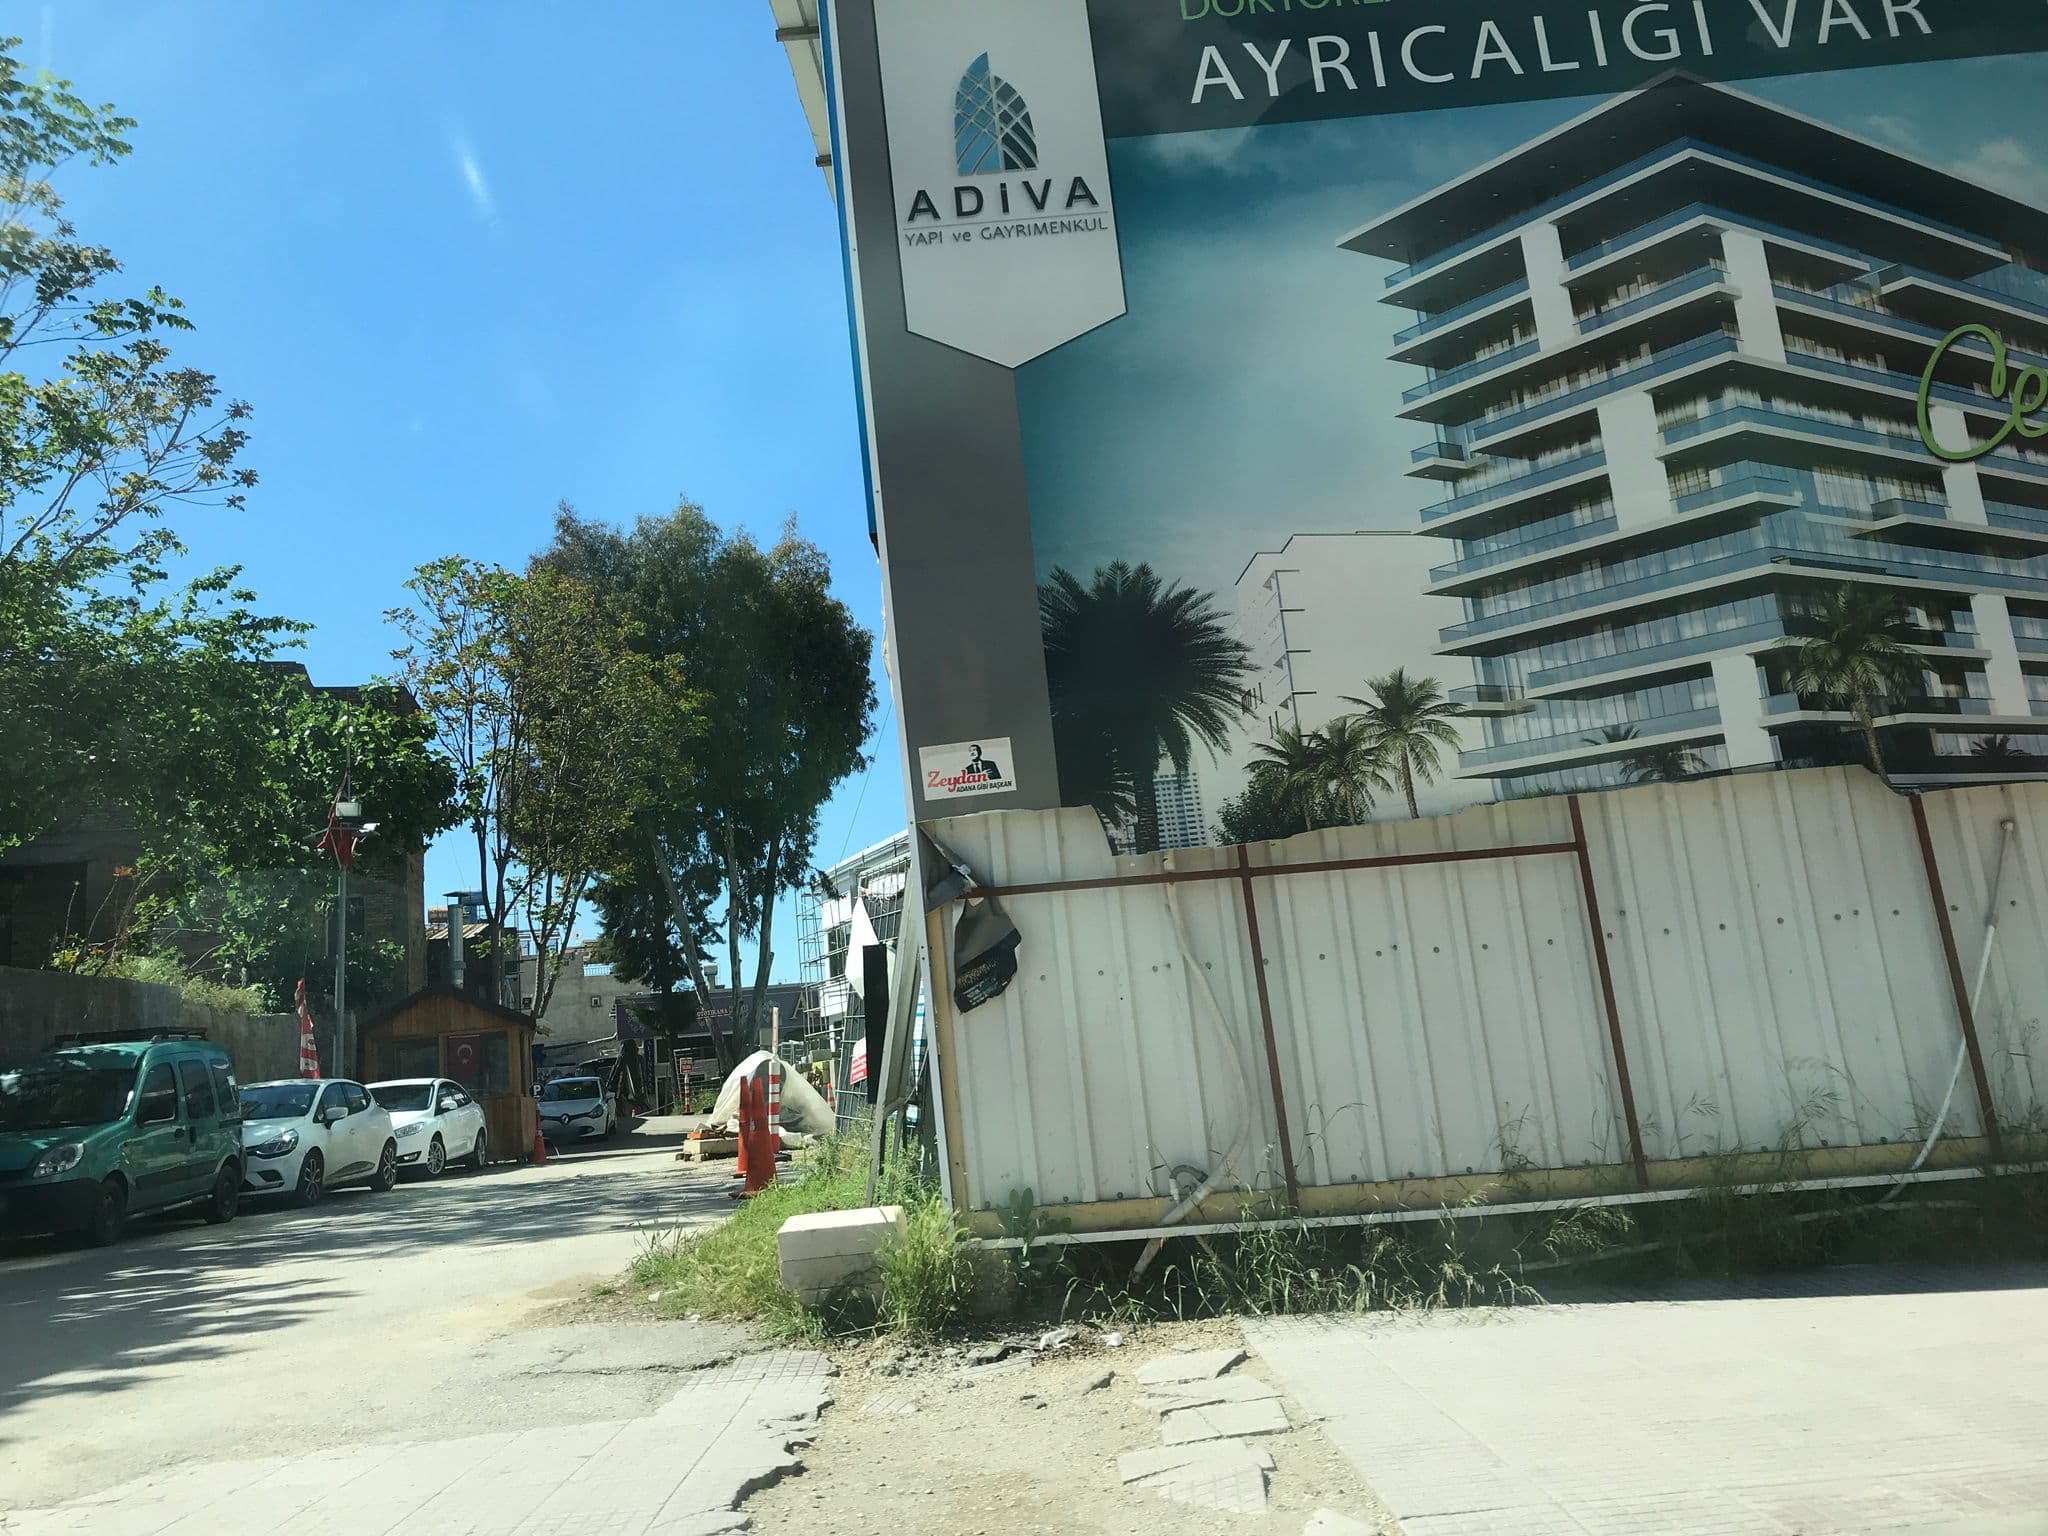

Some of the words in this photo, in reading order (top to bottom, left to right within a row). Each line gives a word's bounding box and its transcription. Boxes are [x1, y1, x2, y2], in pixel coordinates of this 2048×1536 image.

[1750, 0, 1934, 49] VAR
[905, 231, 943, 246] YAPI
[952, 231, 972, 242] ve
[927, 769, 989, 793] Zeydan
[956, 784, 976, 793] ADANA
[989, 780, 1012, 790] BAŞKAN
